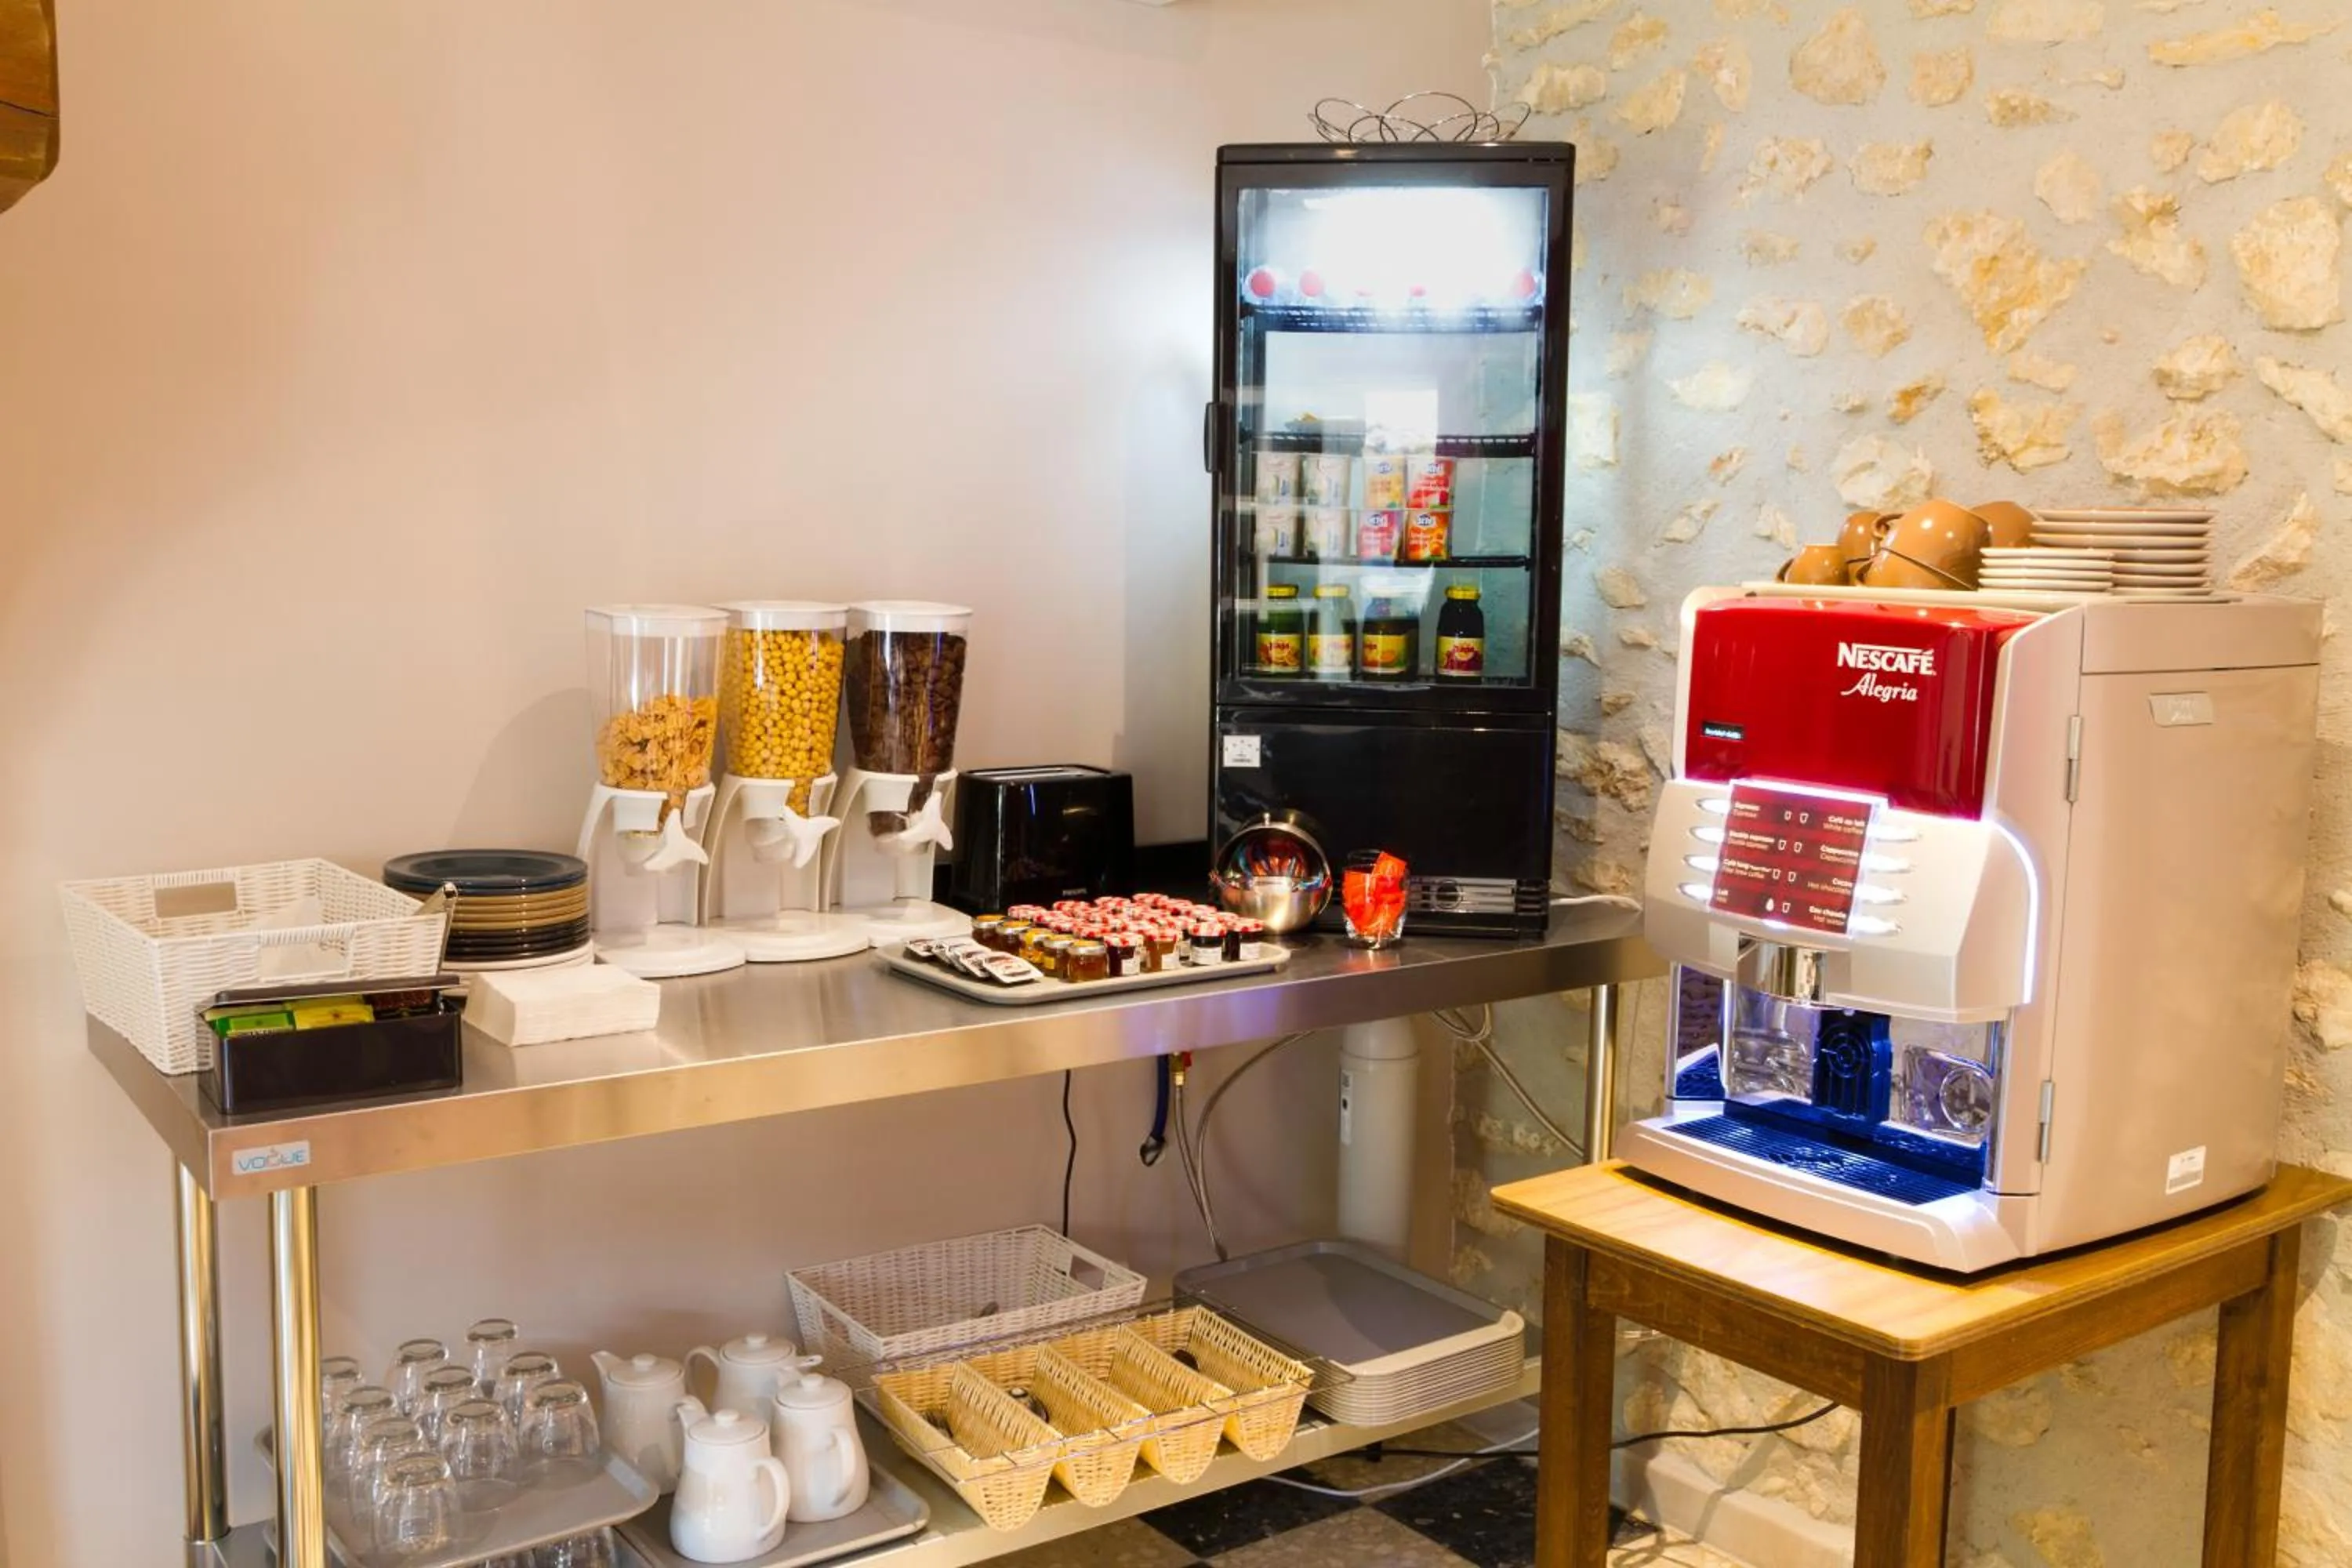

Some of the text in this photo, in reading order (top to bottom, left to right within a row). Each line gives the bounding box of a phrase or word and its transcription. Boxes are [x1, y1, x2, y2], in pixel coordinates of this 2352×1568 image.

[1837, 641, 1934, 675] NESCAFÉ
[1840, 672, 1918, 703] Alegria
[238, 1148, 307, 1171] VOGUE
